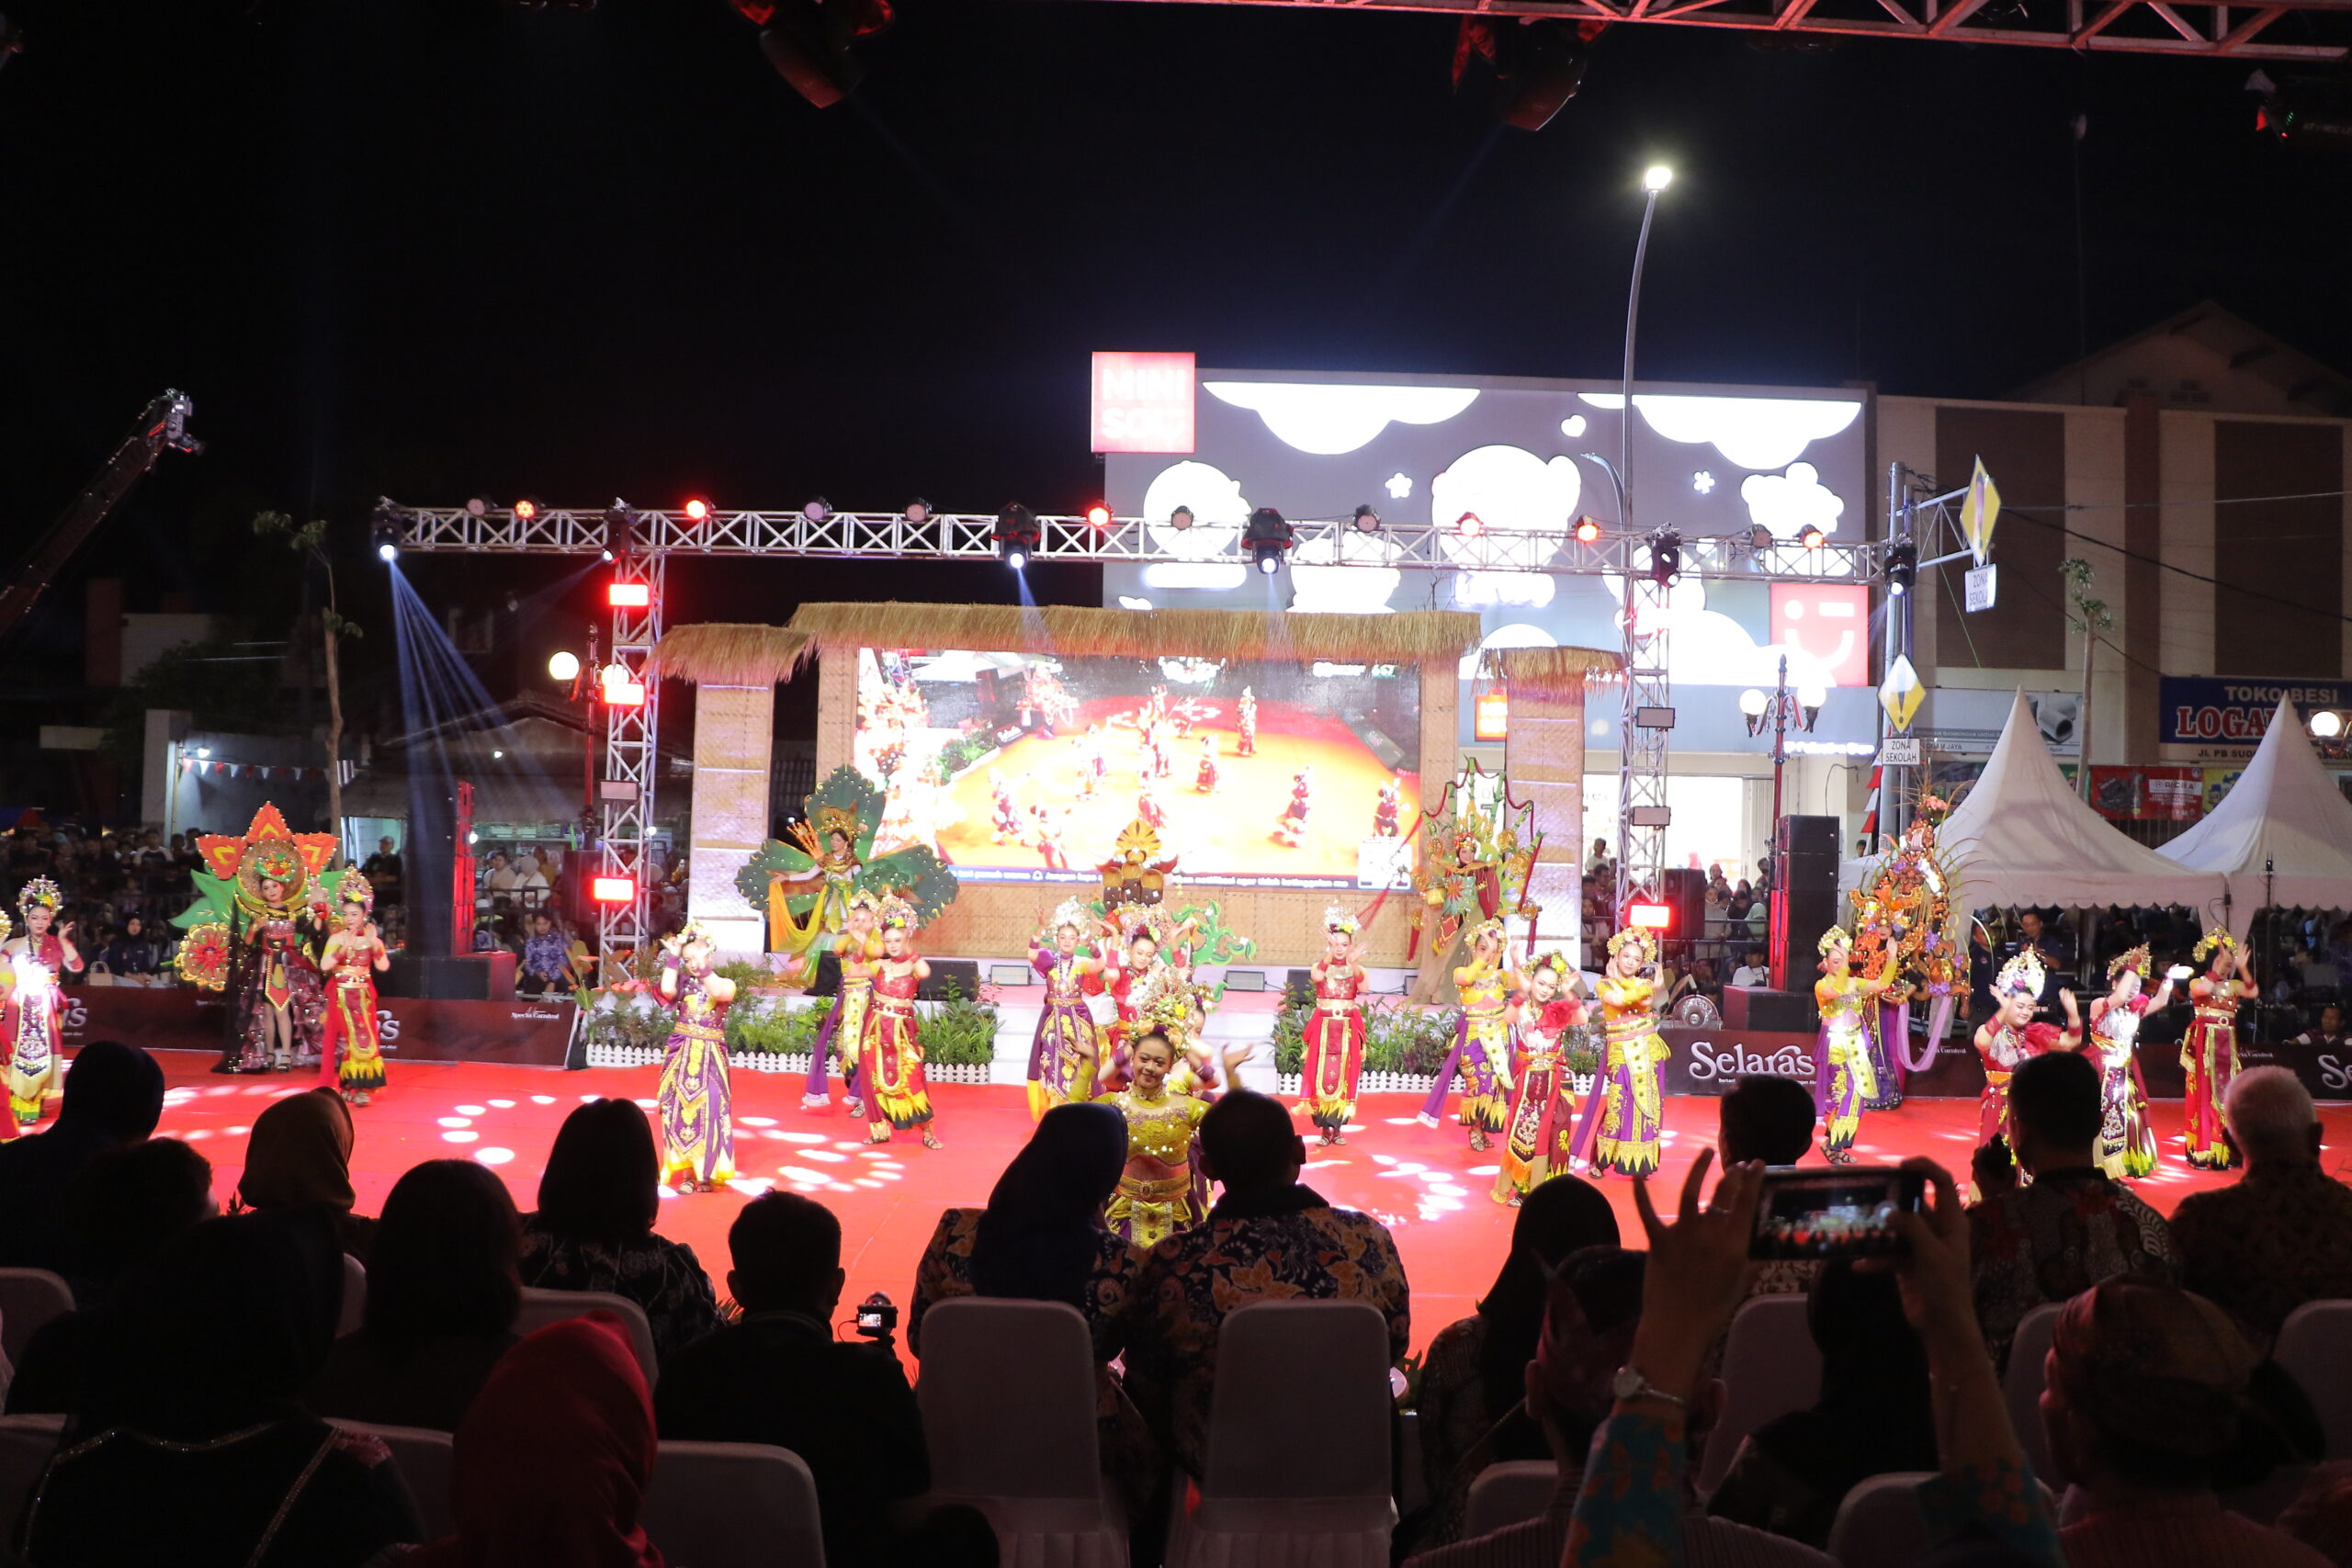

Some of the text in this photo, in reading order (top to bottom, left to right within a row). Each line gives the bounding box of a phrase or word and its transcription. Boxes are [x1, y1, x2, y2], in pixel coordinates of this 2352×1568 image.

[1102, 368, 1186, 400] MINI
[2224, 686, 2338, 703] TOKO BESI
[2175, 705, 2277, 739] LOGA
[1885, 752, 1917, 762] SEKOLAH
[1891, 740, 1911, 750] ZONA
[1689, 1041, 1815, 1079] Selaras
